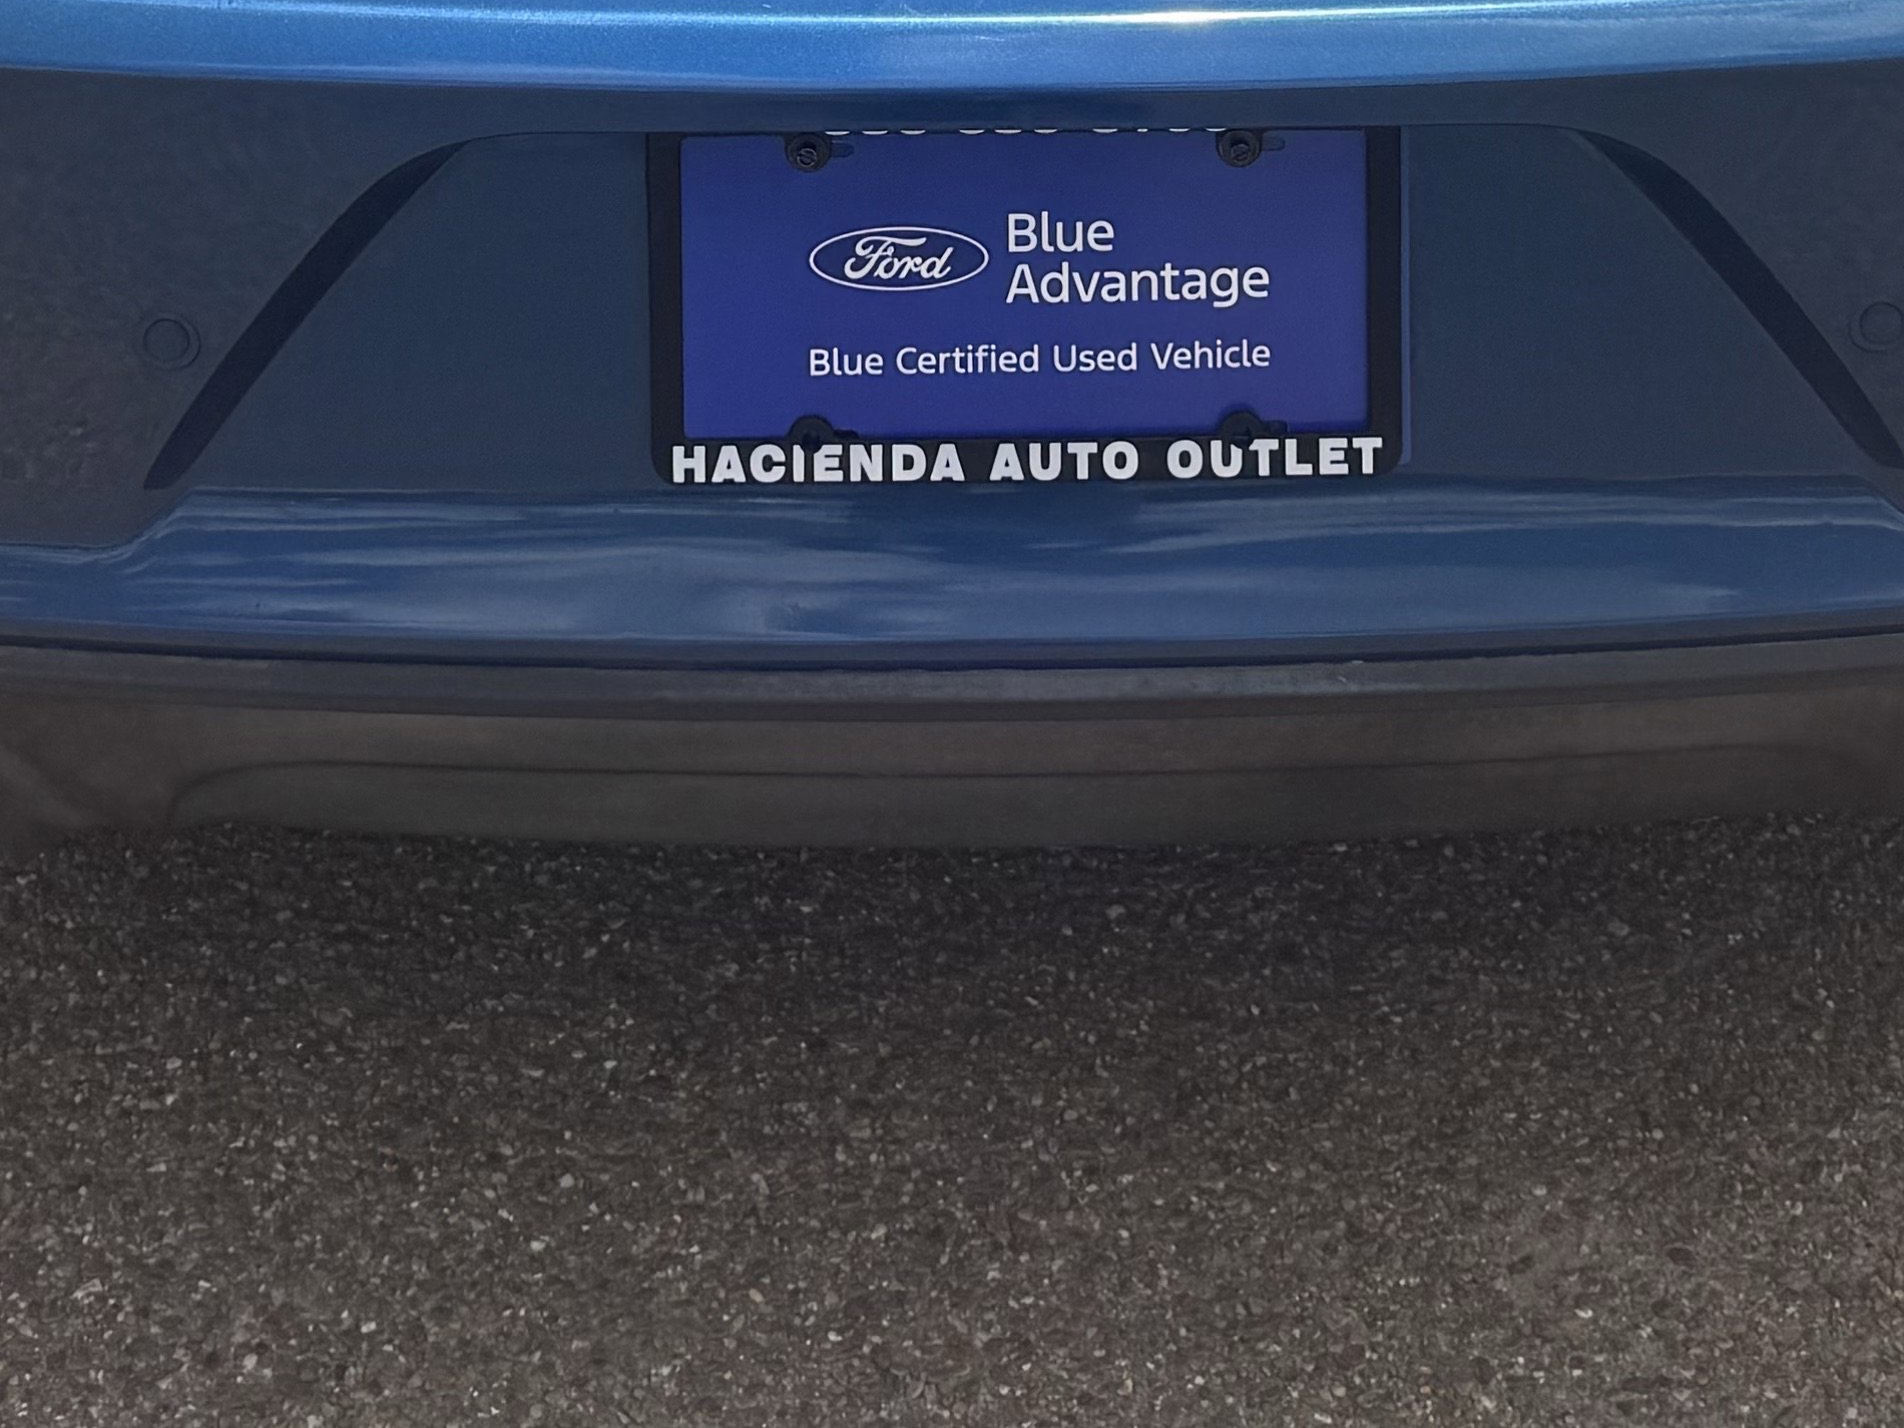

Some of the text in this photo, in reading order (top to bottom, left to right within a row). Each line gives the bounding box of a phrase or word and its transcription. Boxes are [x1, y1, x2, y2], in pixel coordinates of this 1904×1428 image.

[1007, 212, 1116, 253] Blue
[844, 235, 953, 281] Ford
[1005, 260, 1271, 309] Advantage
[808, 338, 1272, 378] Blue Certified Used Vehicle
[670, 435, 1385, 486] HACIENDA AUTO OUTLET
